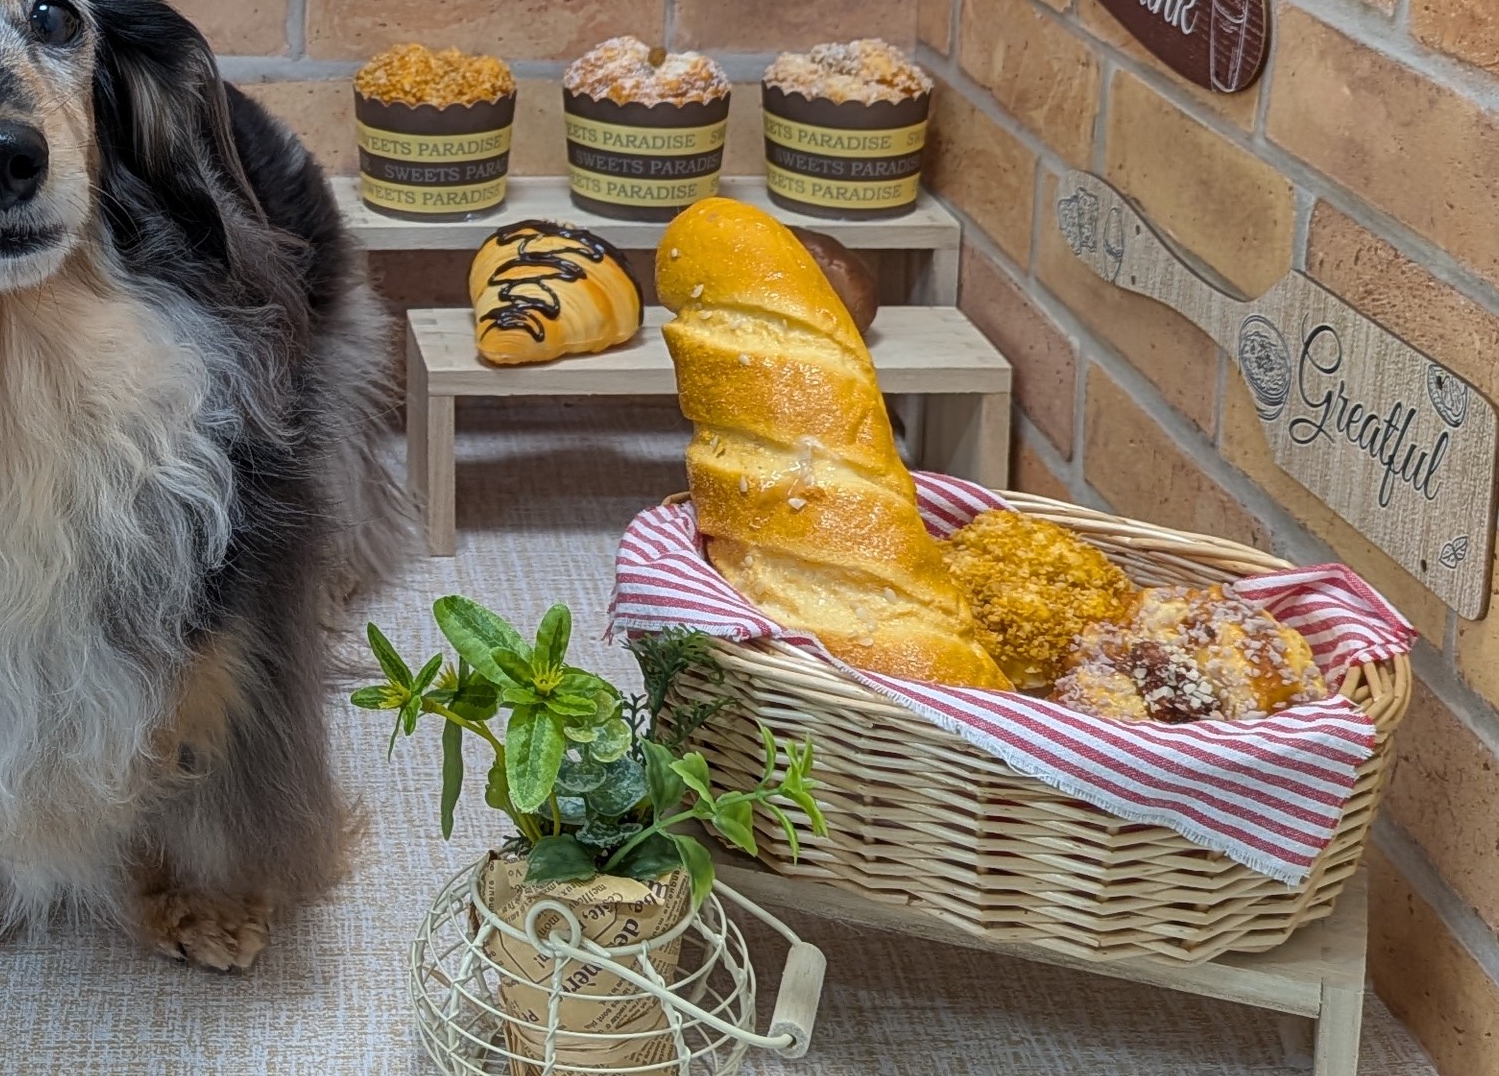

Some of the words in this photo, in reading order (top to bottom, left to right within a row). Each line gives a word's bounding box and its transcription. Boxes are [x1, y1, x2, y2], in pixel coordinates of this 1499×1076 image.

[418, 135, 502, 157] PARADISE
[603, 132, 696, 149] PARADISE
[798, 129, 892, 151] PARADISE
[575, 149, 643, 174] SWEETS
[774, 148, 844, 174] SWEETS
[384, 163, 459, 183] SWEETS
[423, 183, 500, 206] PARADISE
[606, 182, 697, 200] PARADISE
[812, 183, 902, 202] PARADISE
[1288, 312, 1450, 509] Greatful
